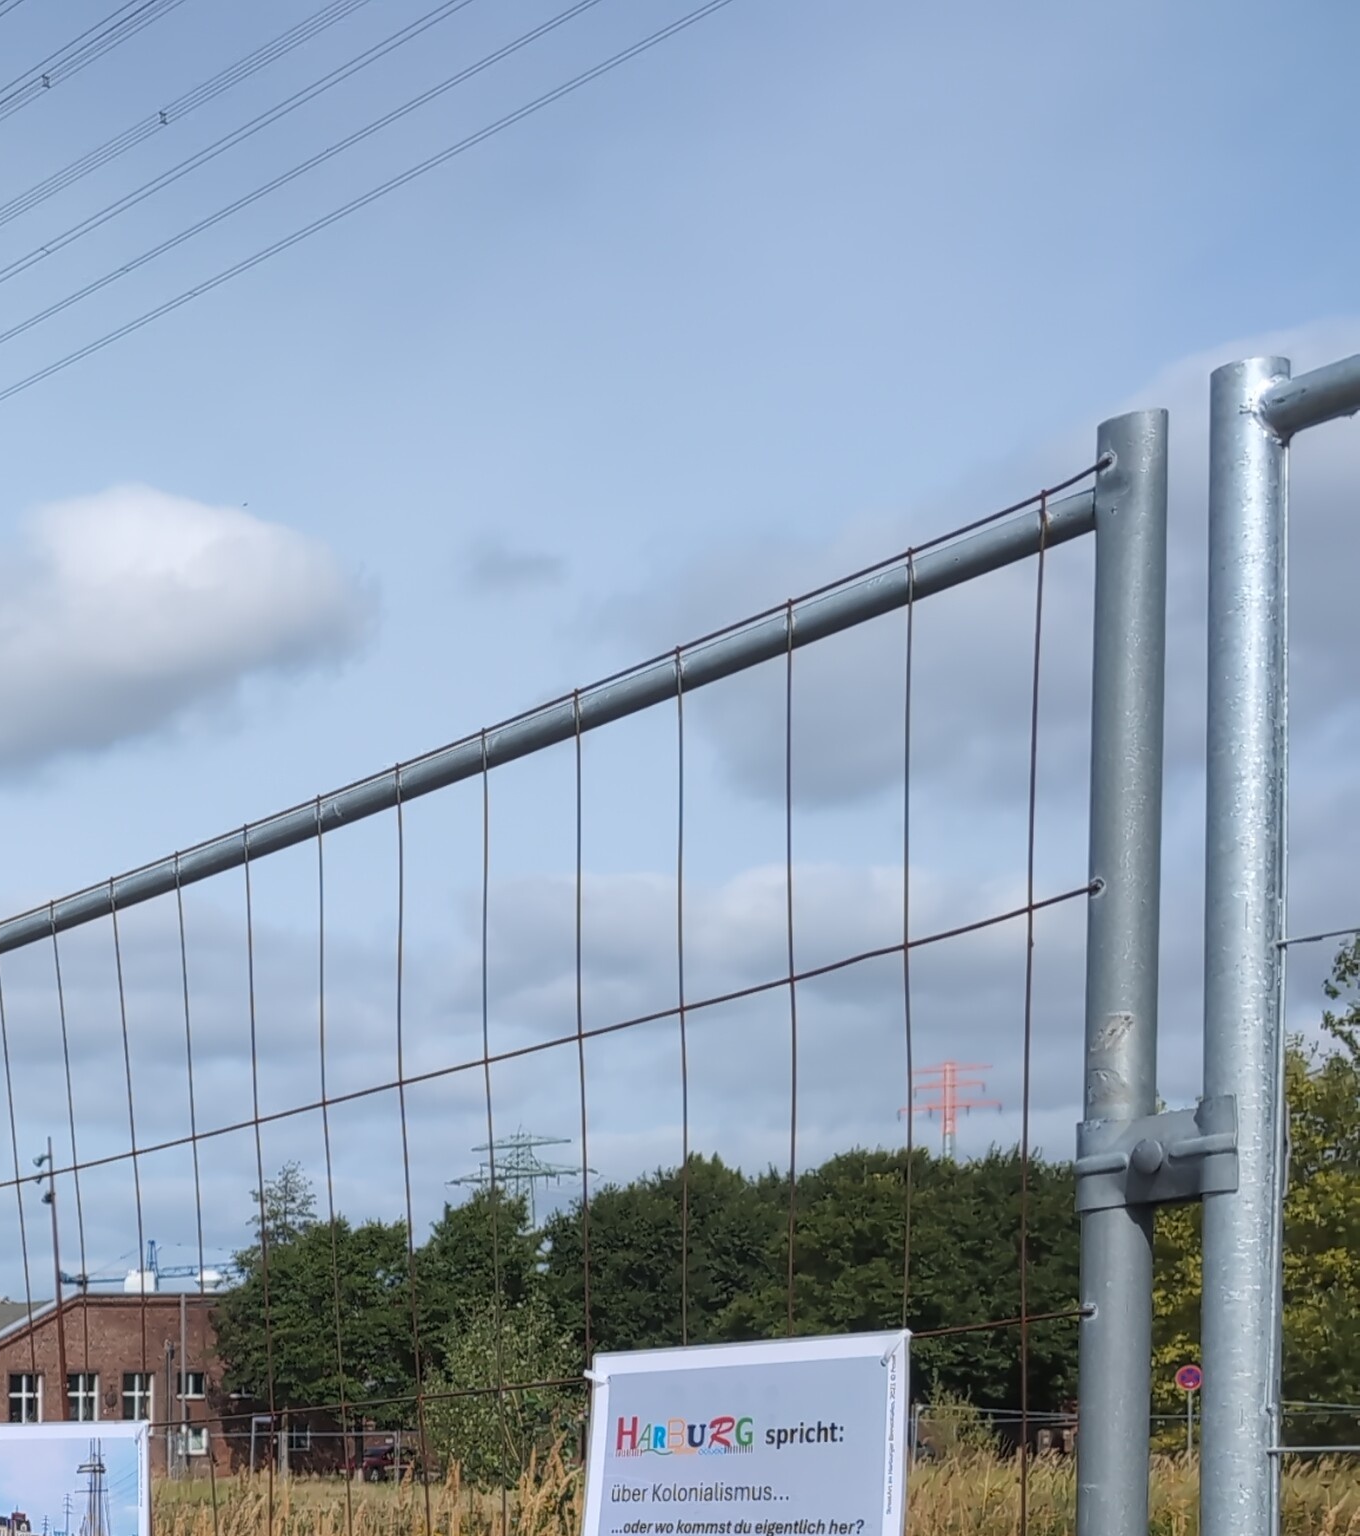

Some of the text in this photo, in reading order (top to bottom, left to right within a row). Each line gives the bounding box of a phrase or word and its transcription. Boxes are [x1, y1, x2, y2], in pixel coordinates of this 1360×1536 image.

[765, 1421, 844, 1450] spricht:
[611, 1482, 789, 1503] über Kolonialismus...
[611, 1520, 653, 1535] ...oder
[655, 1523, 674, 1534] wo
[676, 1520, 731, 1535] kommst
[734, 1519, 752, 1534] du
[828, 1519, 865, 1535] her?
